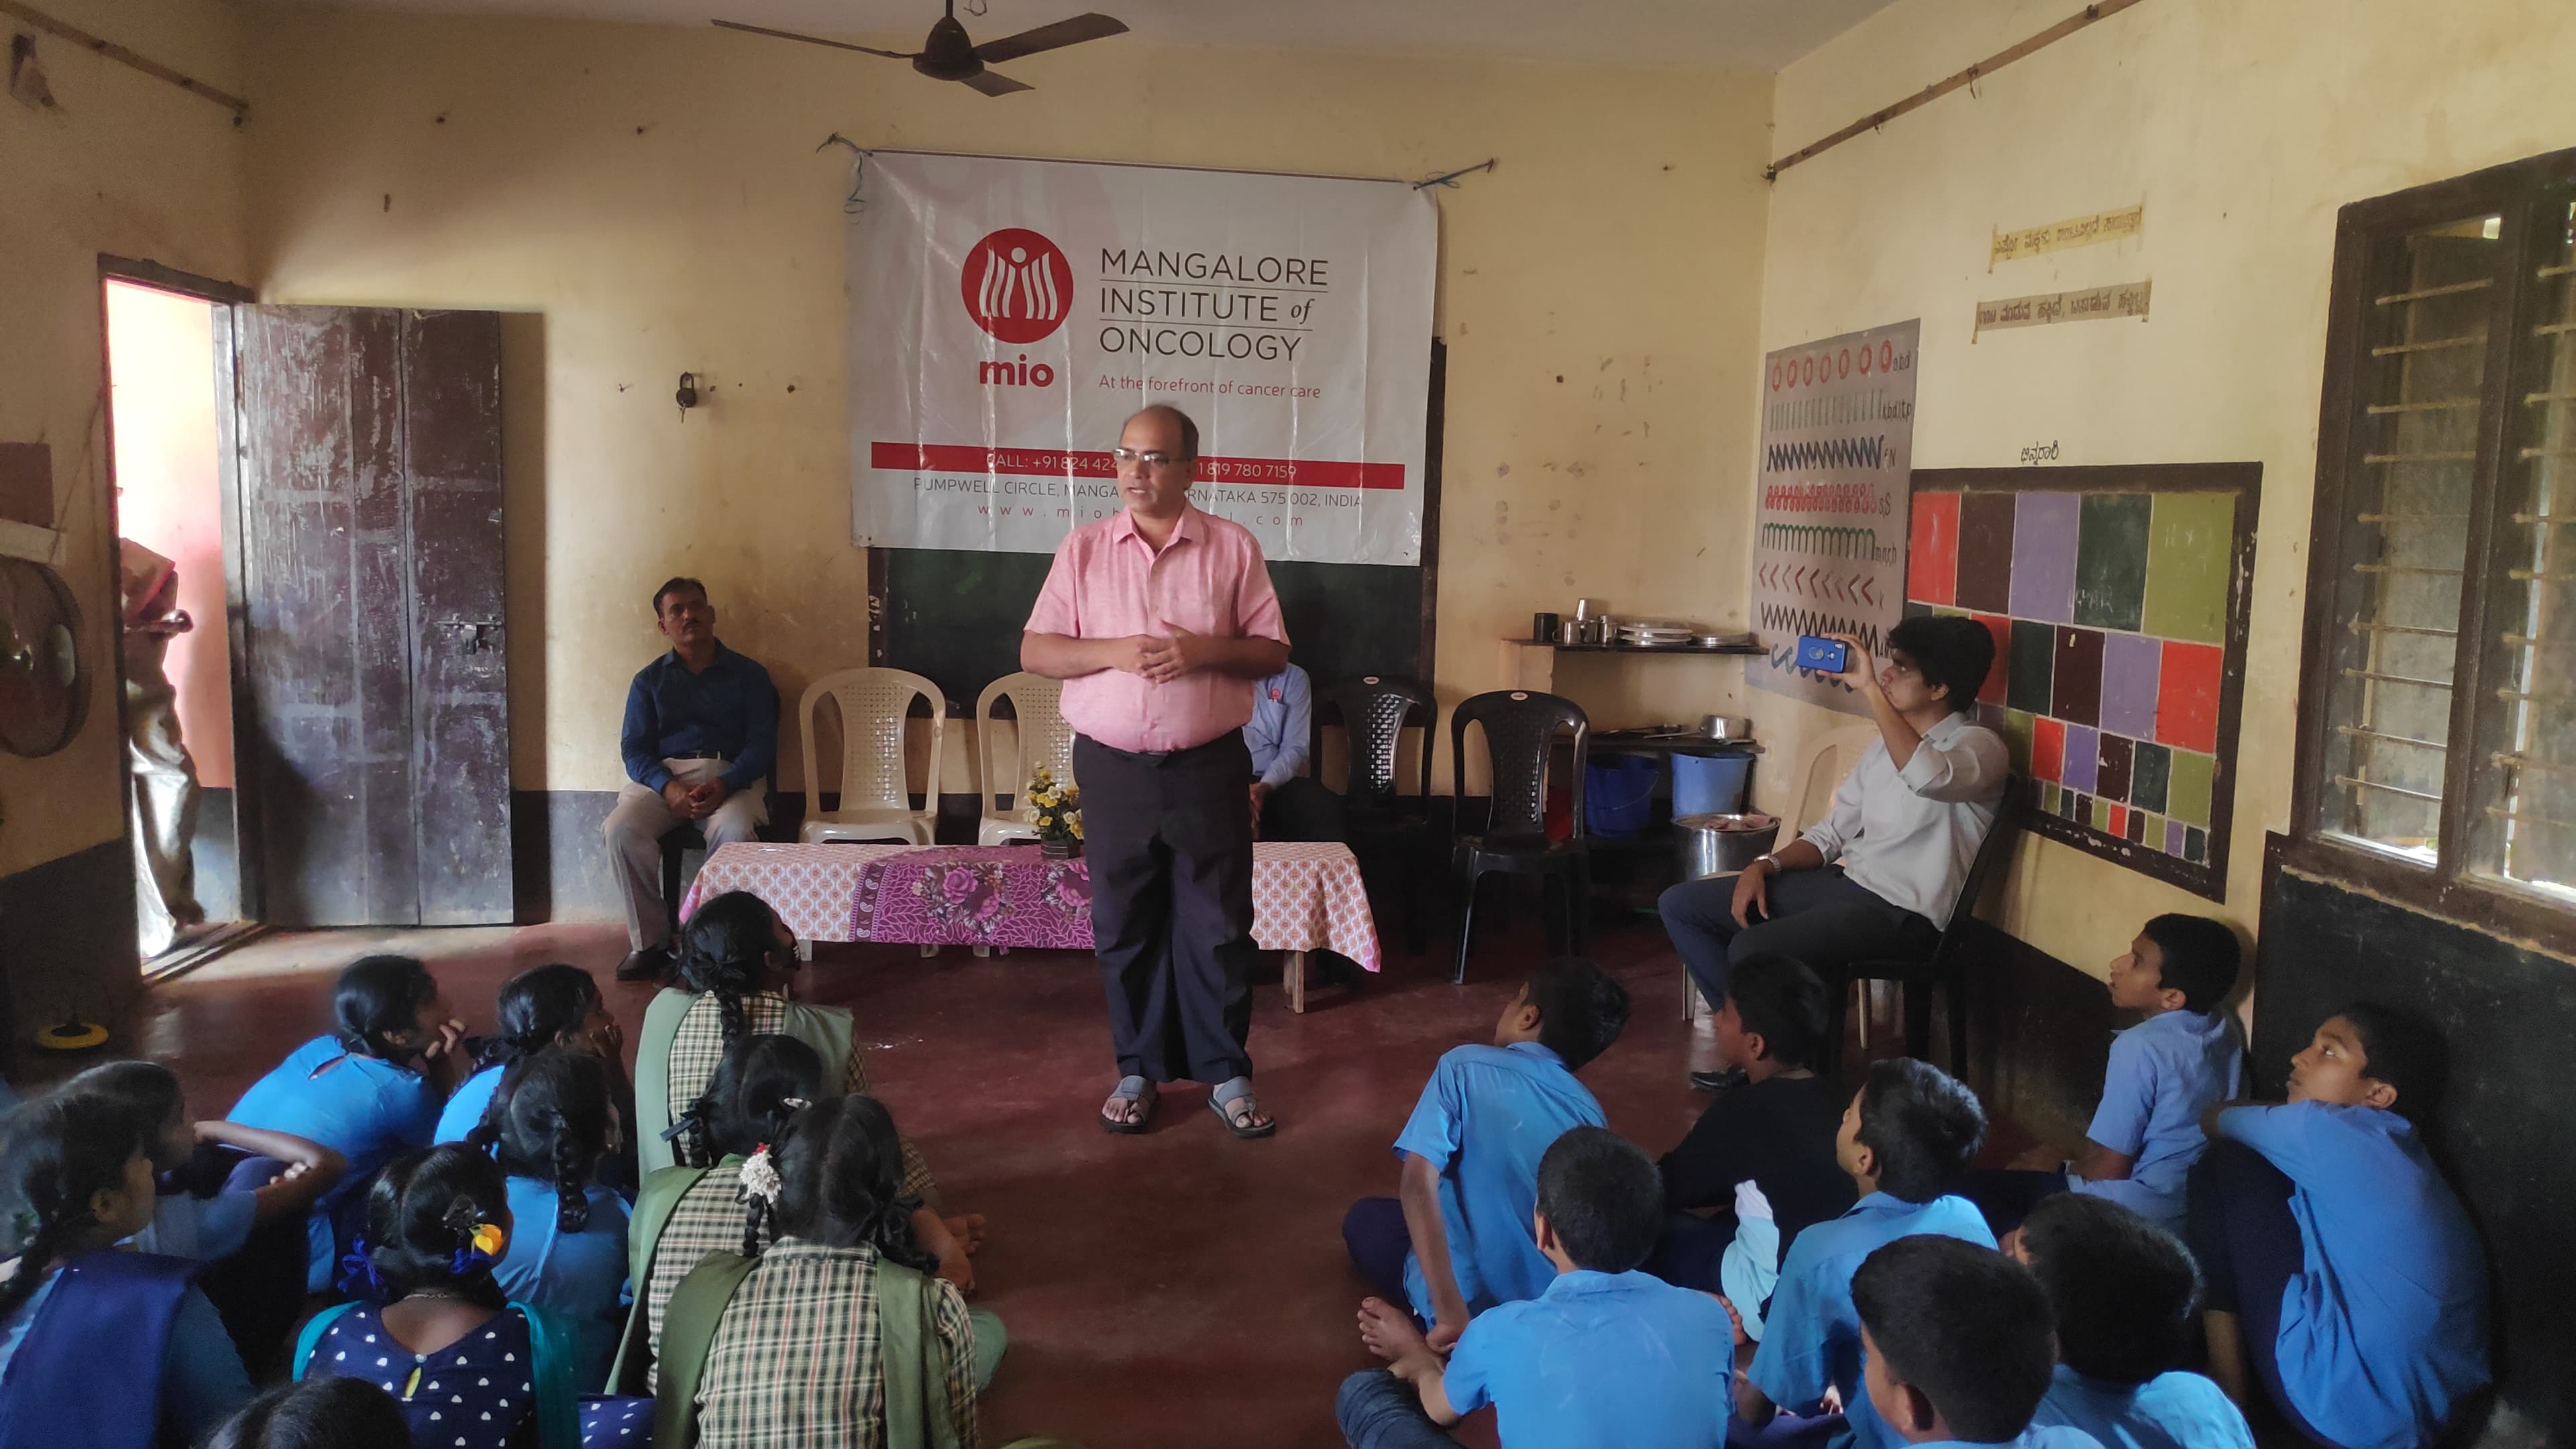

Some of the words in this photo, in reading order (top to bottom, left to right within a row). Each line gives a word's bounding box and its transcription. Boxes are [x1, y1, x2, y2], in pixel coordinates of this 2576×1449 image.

[1102, 248, 1329, 286] MANGALORE
[1100, 287, 1279, 322] INSTITUTE
[1290, 298, 1316, 325] of
[1099, 327, 1302, 362] ONCOLOGY
[979, 353, 1055, 388] mio
[1099, 374, 1117, 390] At
[1120, 376, 1144, 392] the
[1148, 376, 1214, 394] forefront
[1218, 380, 1234, 394] of
[1237, 383, 1286, 397] cancer
[1289, 385, 1322, 399] care
[987, 453, 1028, 468] CALL:
[1032, 455, 1057, 470] +91
[1061, 456, 1088, 470] 824
[1207, 462, 1230, 476] 819
[1234, 464, 1262, 477] 780
[1265, 464, 1297, 479] 7159
[914, 477, 1000, 494] PUMPWELL
[1004, 481, 1060, 497] CIRCLE,
[1064, 483, 1120, 498] MANGA
[1186, 488, 1256, 504] RNATAKA
[1260, 491, 1287, 504] 575
[1289, 492, 1321, 508] 002,
[1325, 494, 1364, 507] INDIA
